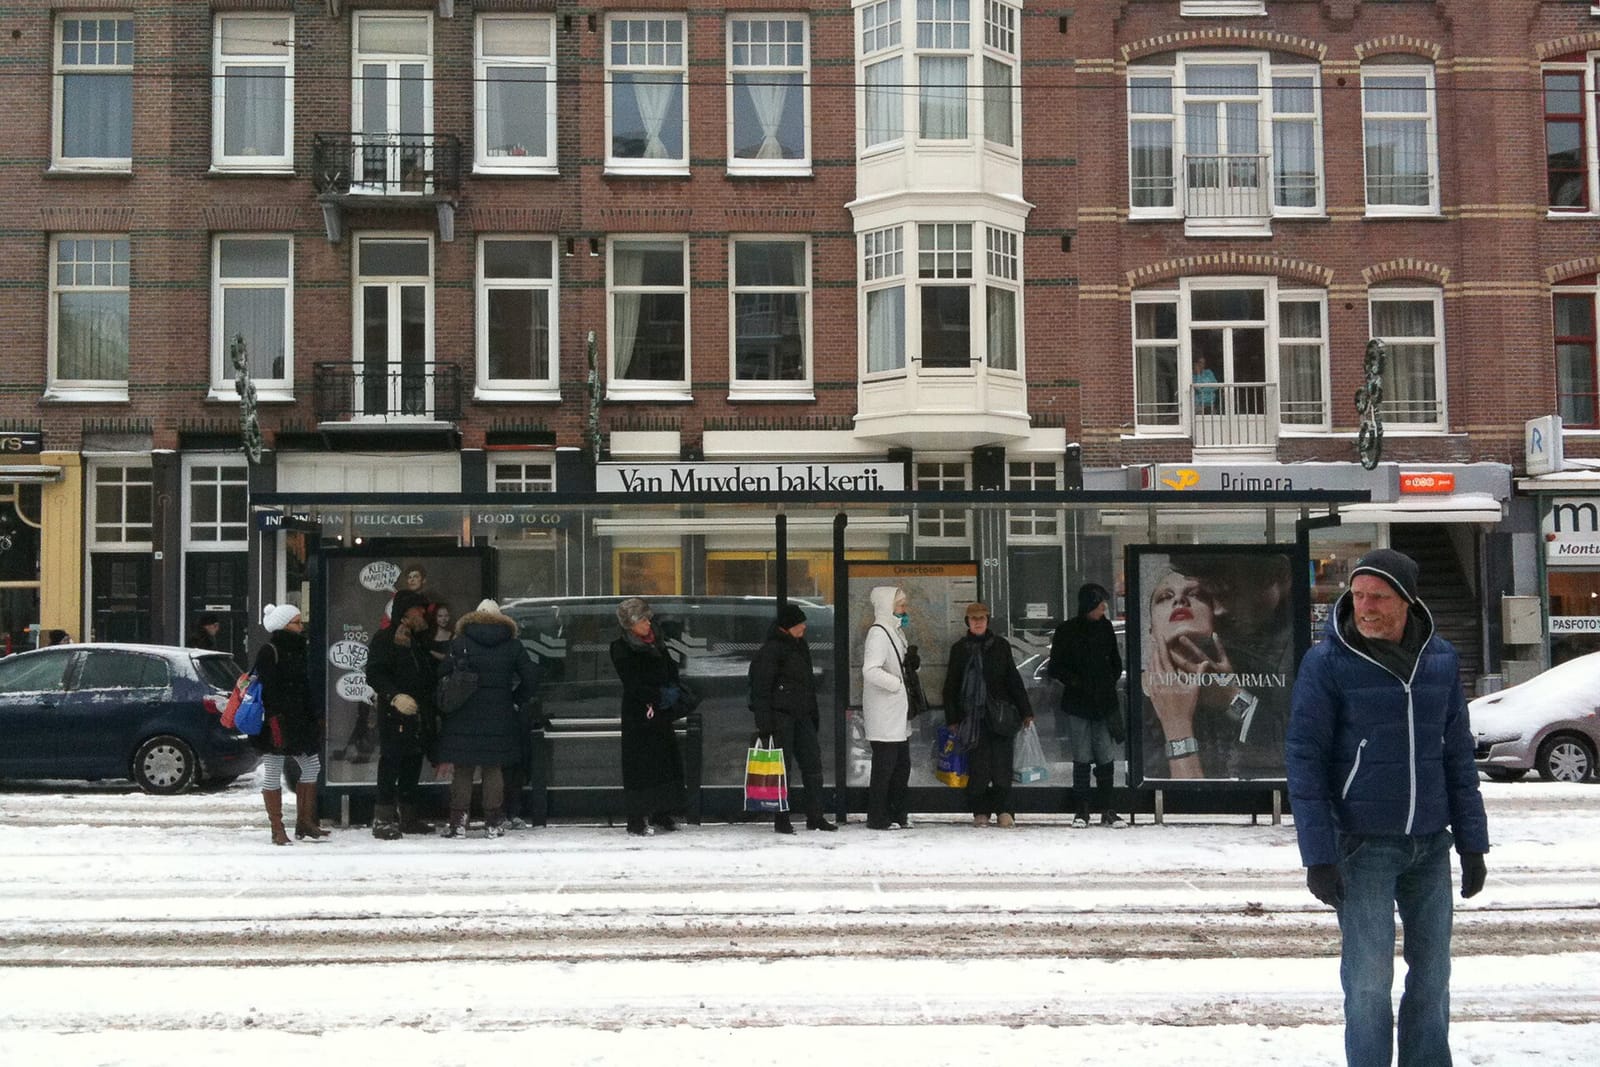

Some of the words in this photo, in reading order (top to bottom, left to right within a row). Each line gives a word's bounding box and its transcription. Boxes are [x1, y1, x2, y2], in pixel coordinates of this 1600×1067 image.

[618, 468, 662, 492] Van
[1221, 472, 1293, 491] Primera
[266, 514, 345, 526] INNSIAN
[354, 514, 424, 525] DELICACIES
[477, 513, 515, 524] FOOD
[519, 513, 537, 524] TO
[541, 513, 561, 524] GO
[335, 642, 344, 655] I
[333, 651, 361, 669] LOVE
[1150, 673, 1213, 687] EMPORIO
[1233, 673, 1286, 687] ARMANI
